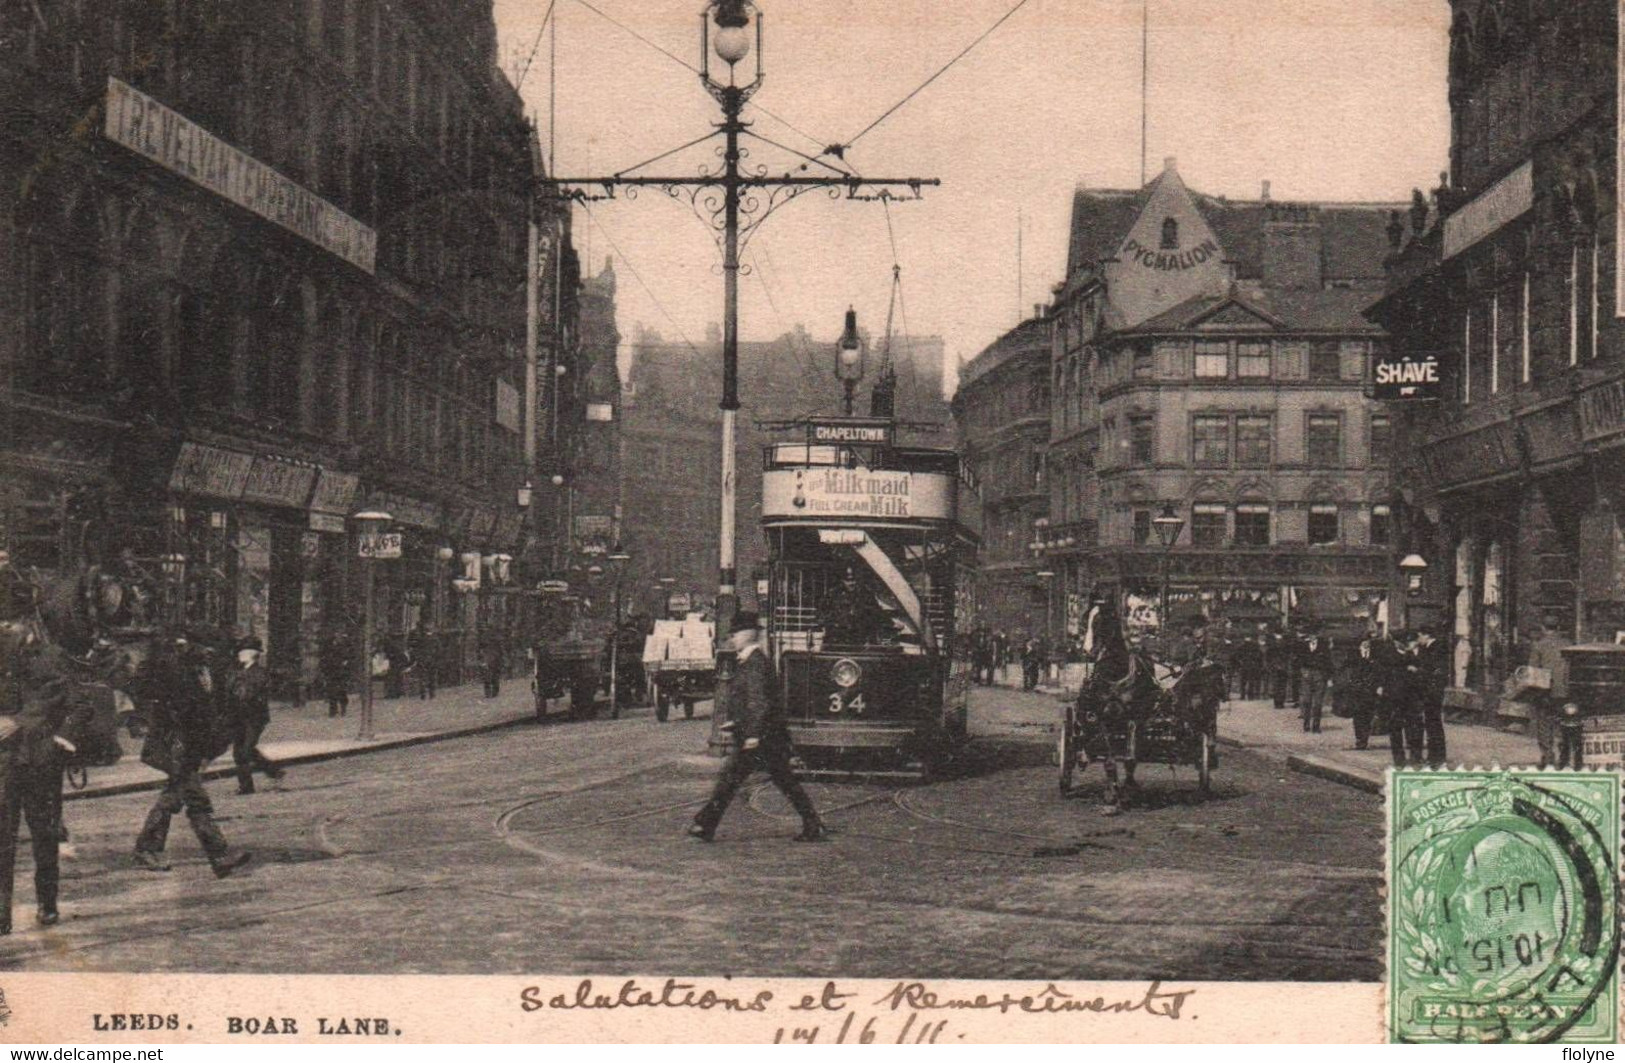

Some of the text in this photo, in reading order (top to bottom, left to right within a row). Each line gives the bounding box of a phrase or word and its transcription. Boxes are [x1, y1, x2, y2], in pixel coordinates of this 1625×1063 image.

[1123, 239, 1218, 271] PYGMALION
[1376, 361, 1440, 384] SHAVE
[816, 426, 884, 440] CHAPELTOWN
[809, 498, 831, 512] FULL
[870, 495, 908, 515] Milk
[828, 692, 866, 714] 34
[1411, 791, 1466, 824] POSTAGE
[520, 976, 774, 1013] Salutations
[789, 981, 857, 1012] et
[1424, 1003, 1490, 1018] HALF
